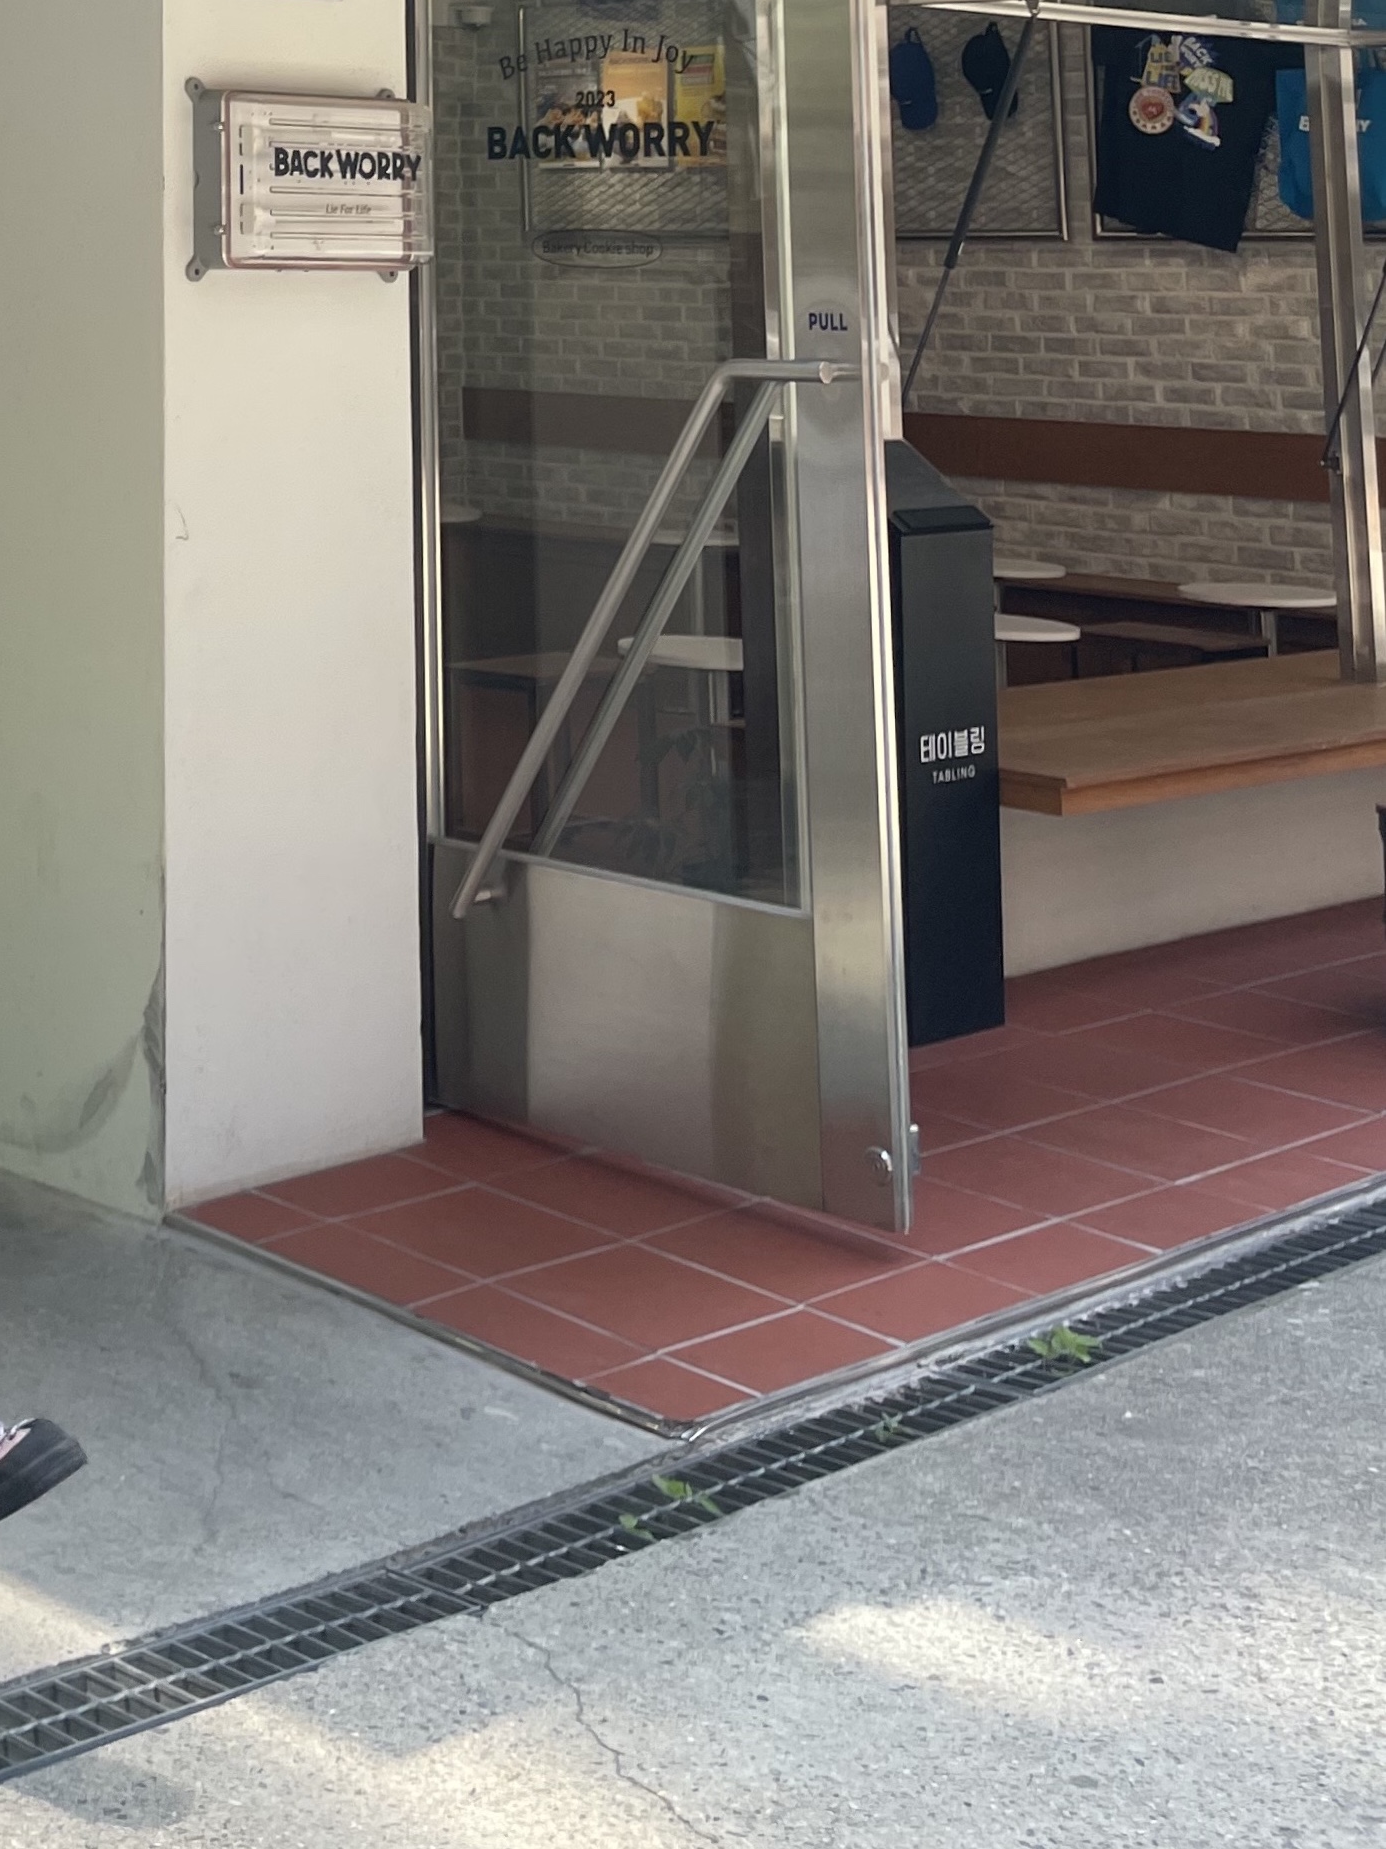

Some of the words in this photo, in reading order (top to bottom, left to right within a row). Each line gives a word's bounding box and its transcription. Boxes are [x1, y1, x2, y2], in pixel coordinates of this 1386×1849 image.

[498, 52, 528, 81] Be
[534, 33, 612, 65] Happy
[621, 28, 647, 55] In
[651, 34, 695, 74] Joy
[575, 89, 616, 108] 2023
[808, 312, 848, 331] PULL
[920, 725, 985, 764] 테이블링
[932, 764, 976, 784] TABLING
